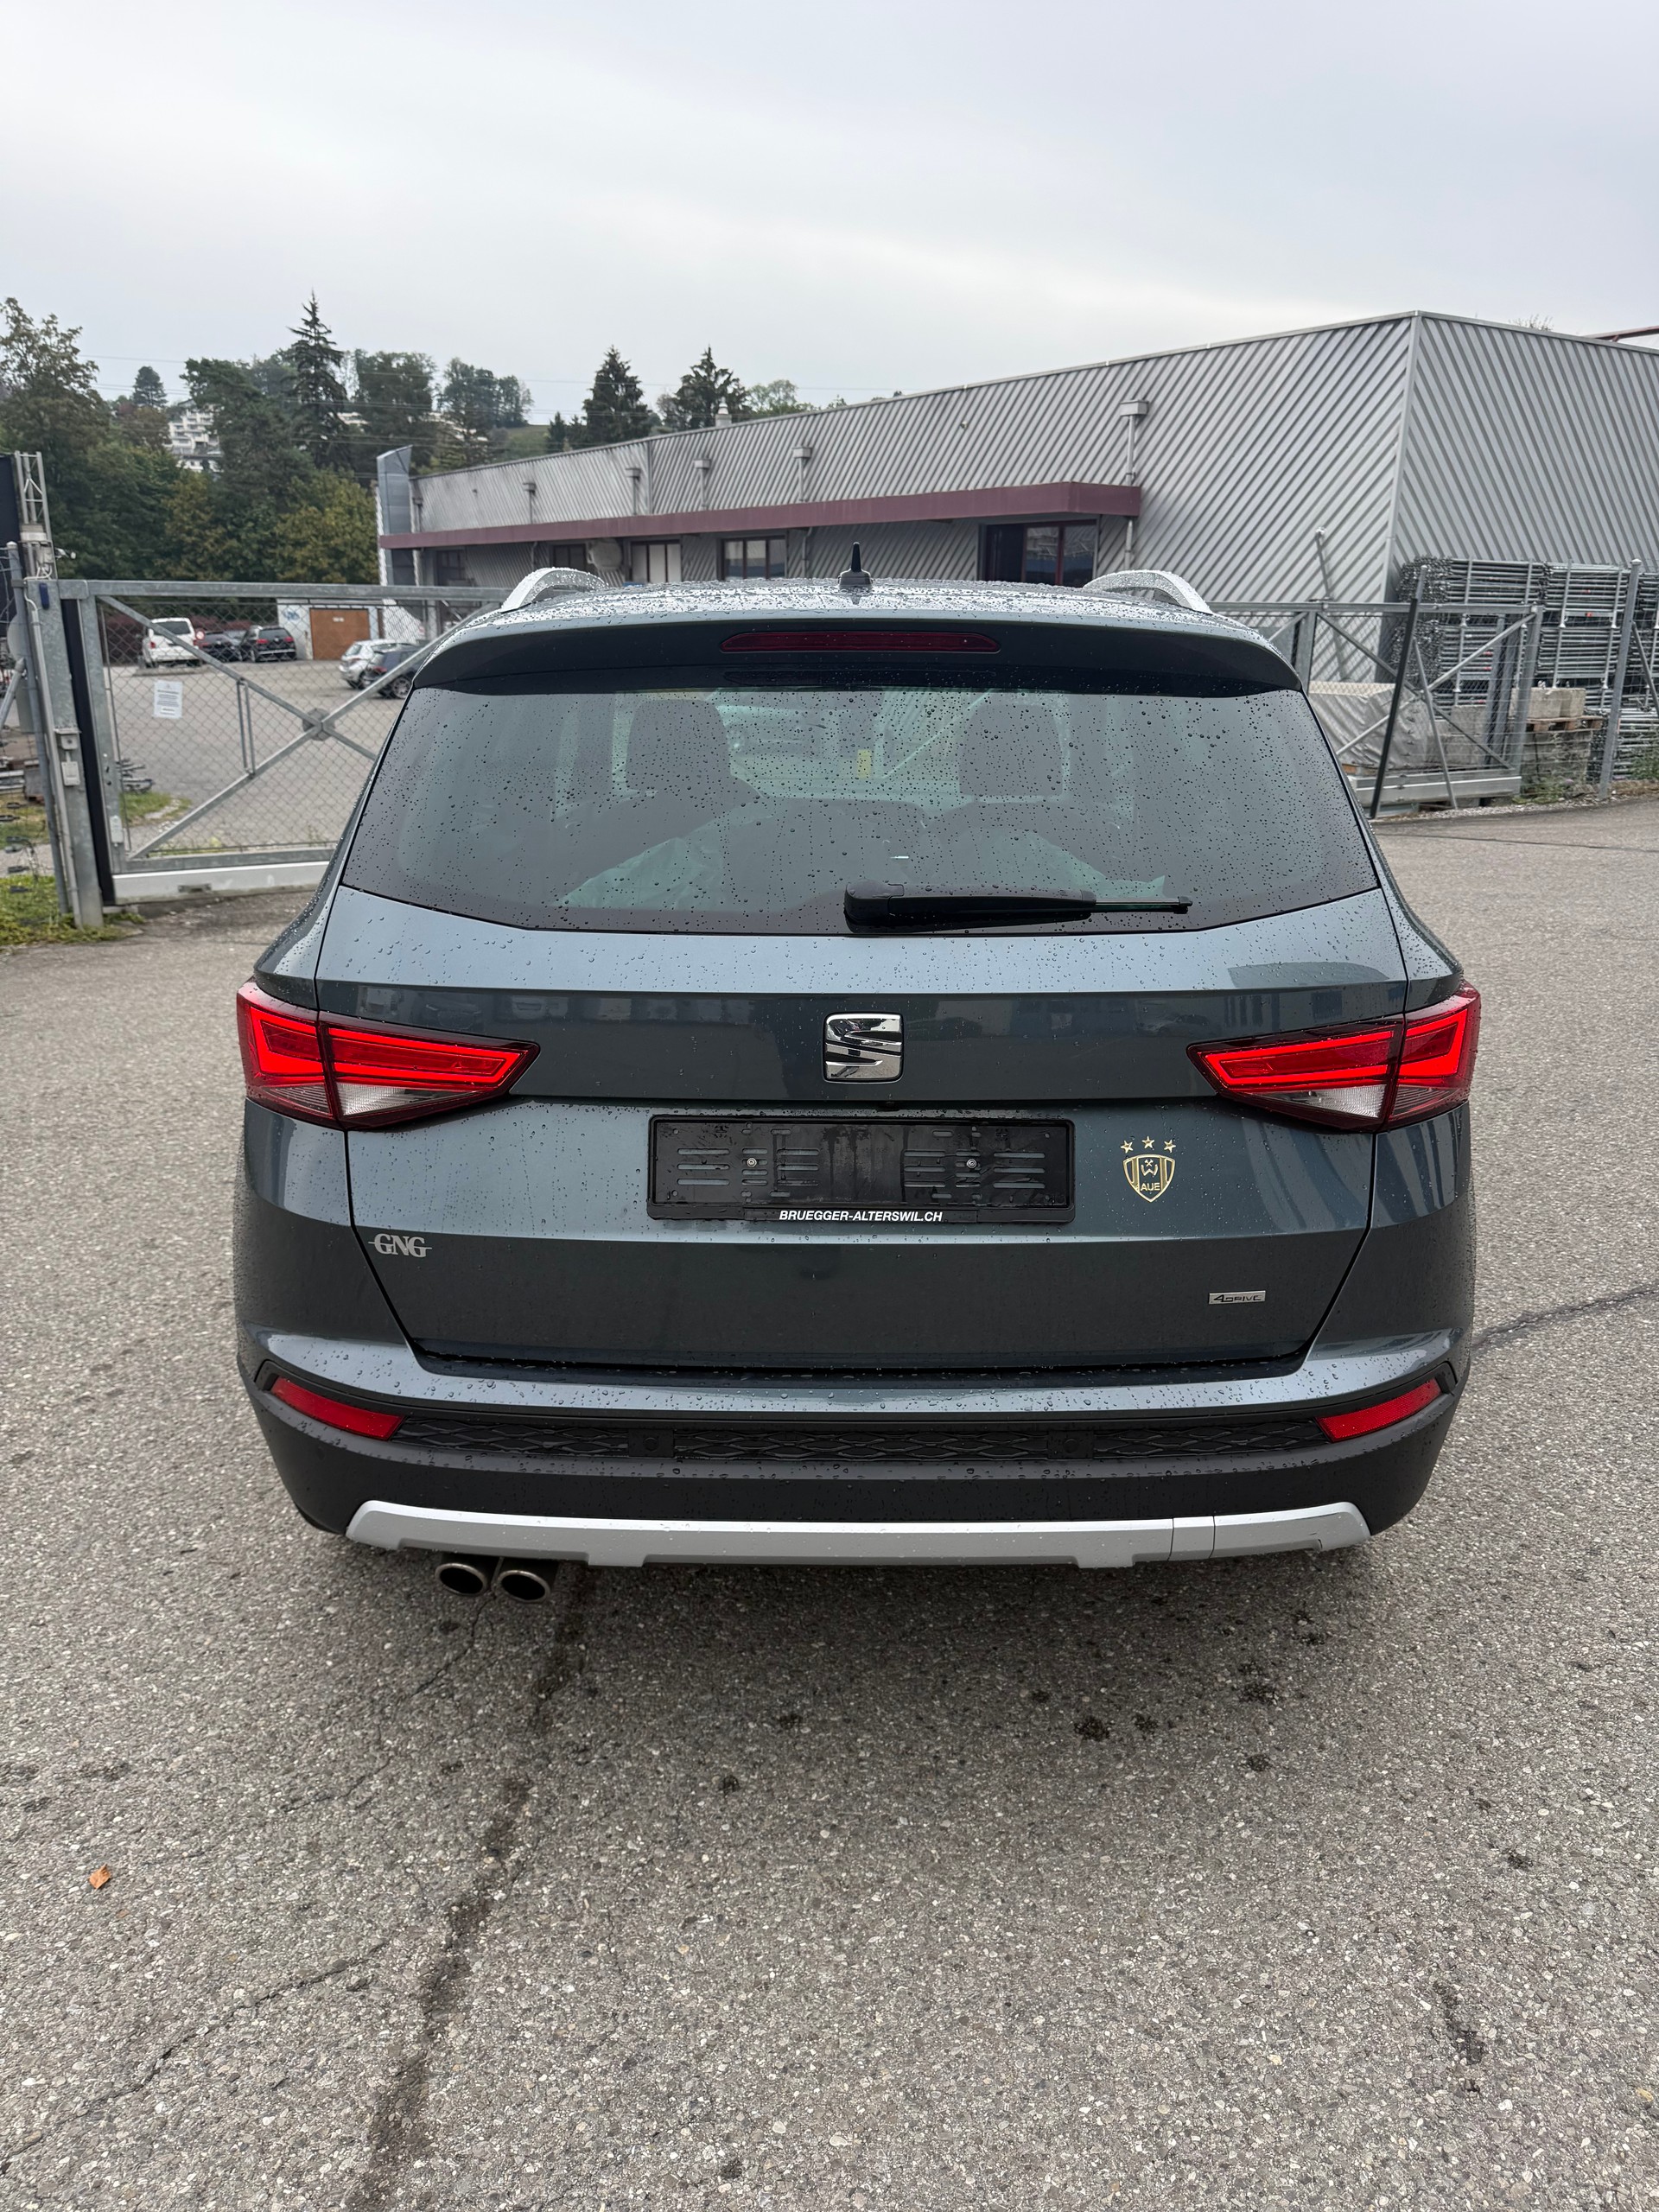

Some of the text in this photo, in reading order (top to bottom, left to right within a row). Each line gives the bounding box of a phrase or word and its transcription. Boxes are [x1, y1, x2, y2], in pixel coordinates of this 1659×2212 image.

[1141, 1182, 1160, 1192] AUE
[779, 1210, 943, 1222] BRUEGGER-ALTERSWIL.CH
[368, 1233, 432, 1258] GNG
